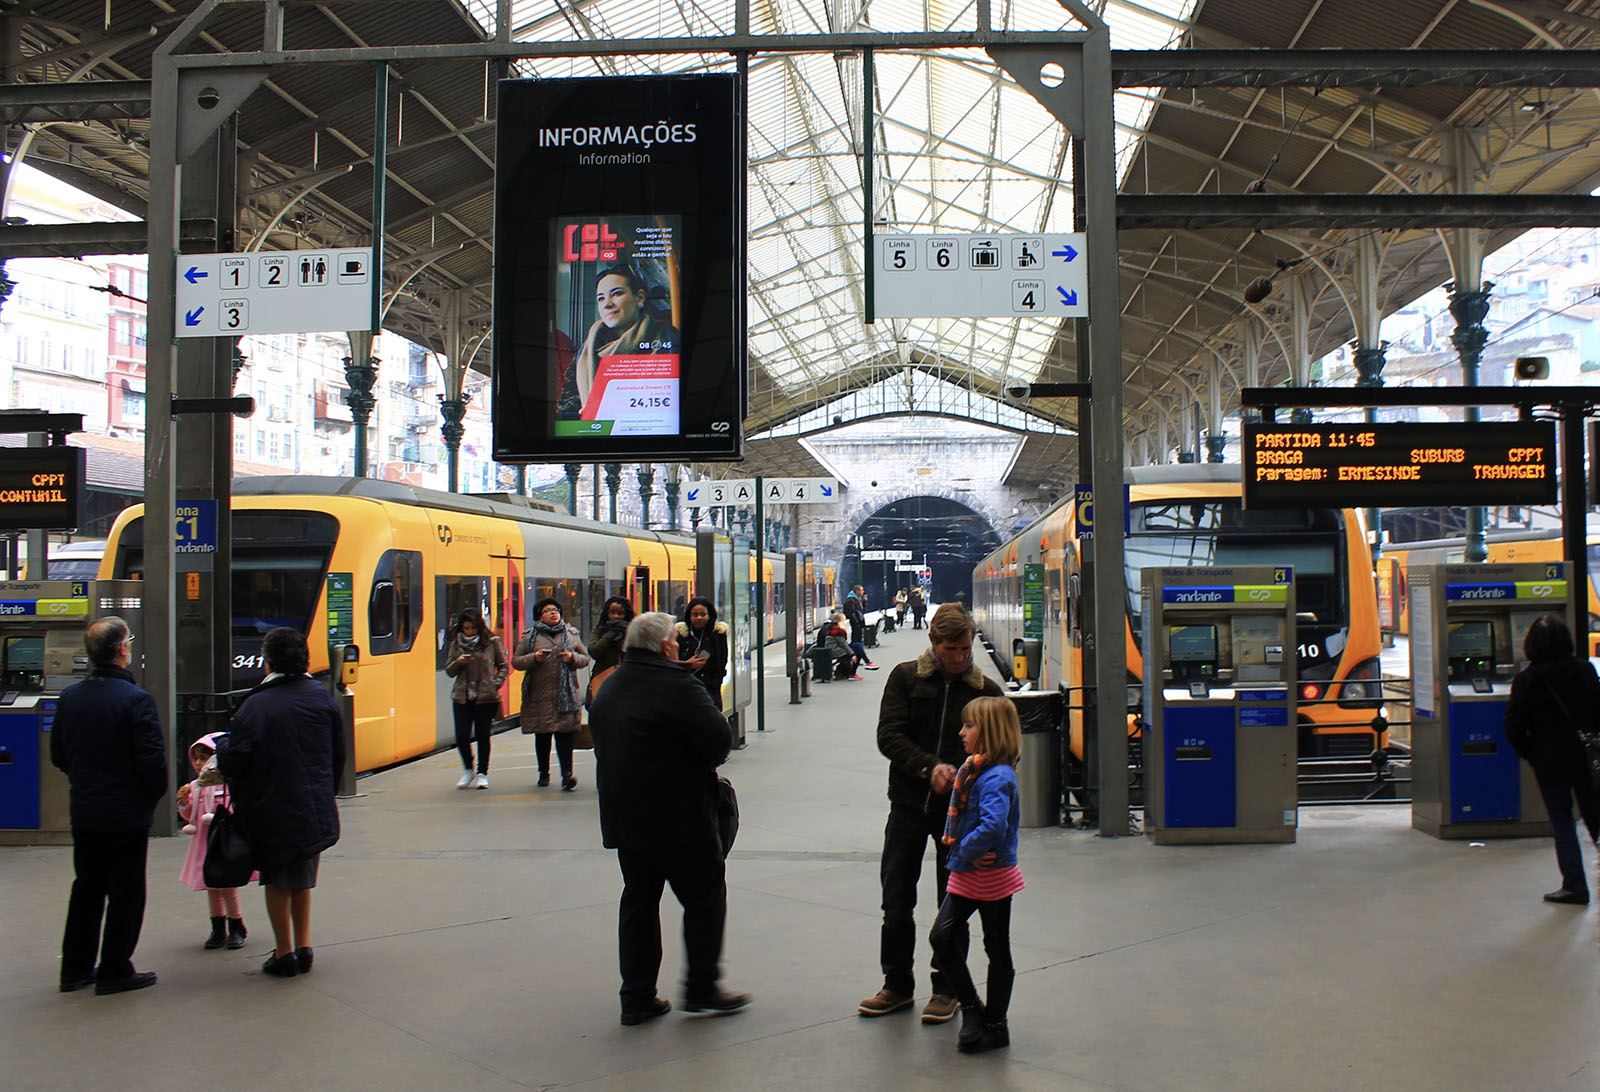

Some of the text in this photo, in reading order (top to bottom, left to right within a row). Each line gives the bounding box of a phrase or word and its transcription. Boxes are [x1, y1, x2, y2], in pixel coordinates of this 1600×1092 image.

[538, 121, 697, 149] INFORMAÇÕES
[579, 152, 651, 165] Information
[224, 259, 245, 267] Linha
[264, 258, 285, 266] Linha
[893, 250, 907, 269] 5
[936, 248, 950, 268] 6
[230, 268, 240, 286] 1
[267, 266, 281, 285] 2
[1017, 281, 1039, 289] Linha
[1021, 290, 1036, 310] 4
[227, 308, 240, 328] 3
[630, 397, 671, 408] 24,15€
[1255, 432, 1375, 448] PARTIDA 11:45
[1255, 447, 1544, 465] BRAGA SUBURB CPPT
[1255, 464, 1545, 482] Paragem: ERMESINDE TRAVAGEM
[31, 474, 65, 487] CPPT
[0, 489, 67, 503] CONTUMIL
[714, 489, 723, 501] 3
[737, 486, 749, 499] A
[769, 485, 781, 498] A
[796, 487, 805, 499] 4
[1078, 491, 1093, 501] zo
[176, 507, 199, 516] ona
[1078, 501, 1093, 527] C
[175, 516, 198, 540] C1
[176, 542, 215, 552] ndante
[1175, 590, 1223, 602] andante
[1461, 587, 1506, 599] andante
[0, 603, 26, 615] dante
[1297, 643, 1319, 658] 10
